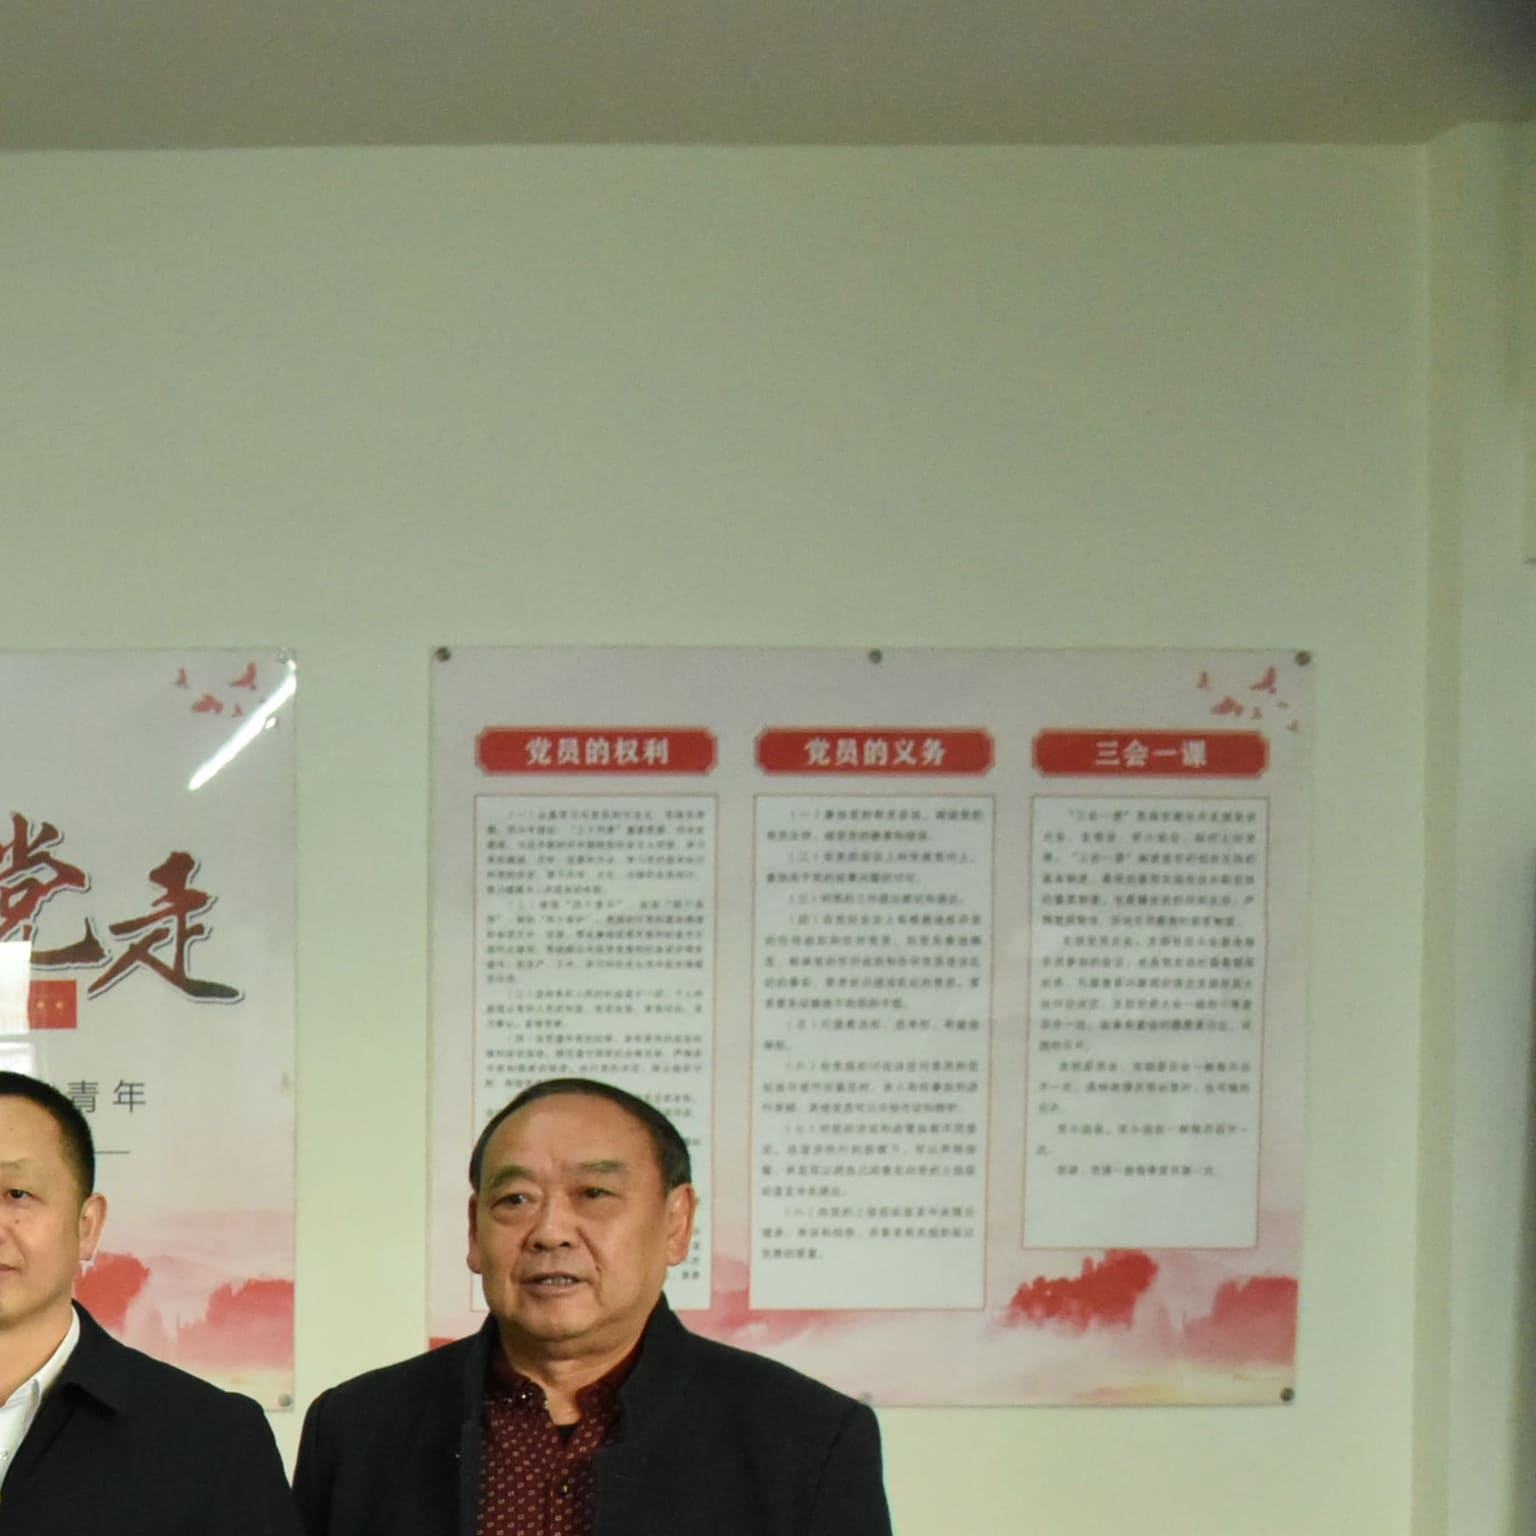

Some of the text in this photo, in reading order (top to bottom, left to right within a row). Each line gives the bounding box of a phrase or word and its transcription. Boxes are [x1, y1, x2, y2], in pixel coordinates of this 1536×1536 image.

[526, 738, 670, 765] 党员的权利
[804, 738, 947, 766] 党员的义务
[1095, 739, 1208, 768] 三会一课
[58, 1079, 148, 1116] 青年
